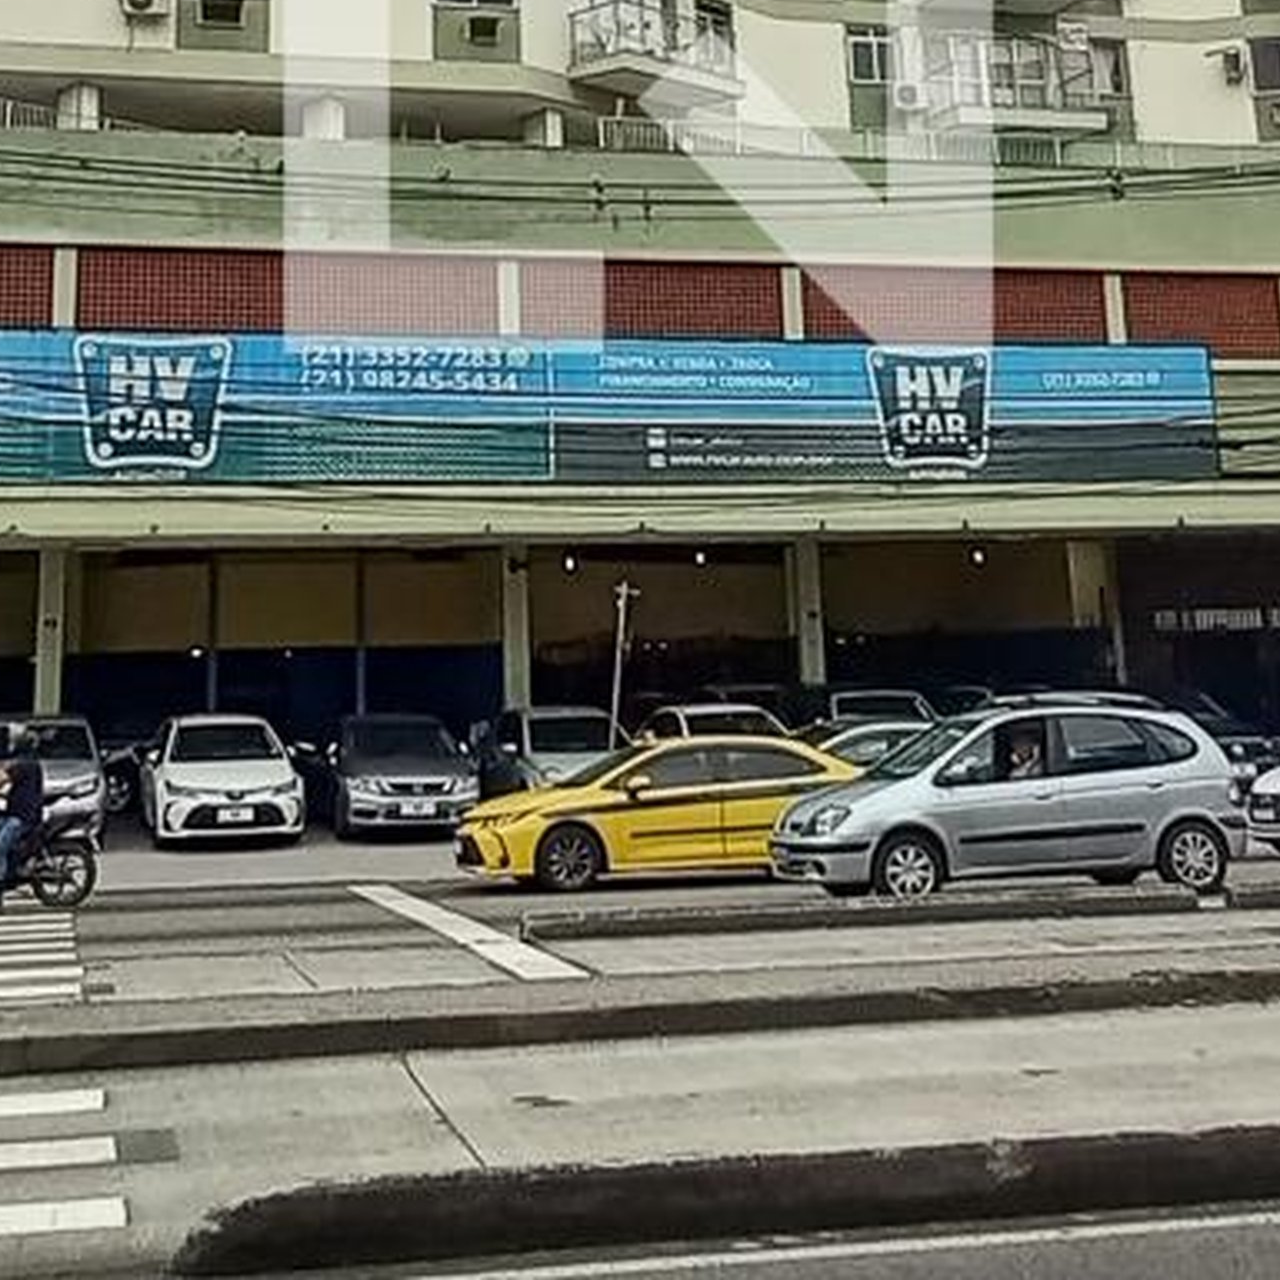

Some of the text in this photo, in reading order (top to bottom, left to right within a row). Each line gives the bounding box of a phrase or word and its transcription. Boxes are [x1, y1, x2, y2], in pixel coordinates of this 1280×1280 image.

[108, 355, 197, 404] HV
[895, 366, 964, 409] HV
[108, 406, 194, 440] CAR
[899, 413, 968, 444] CAR
